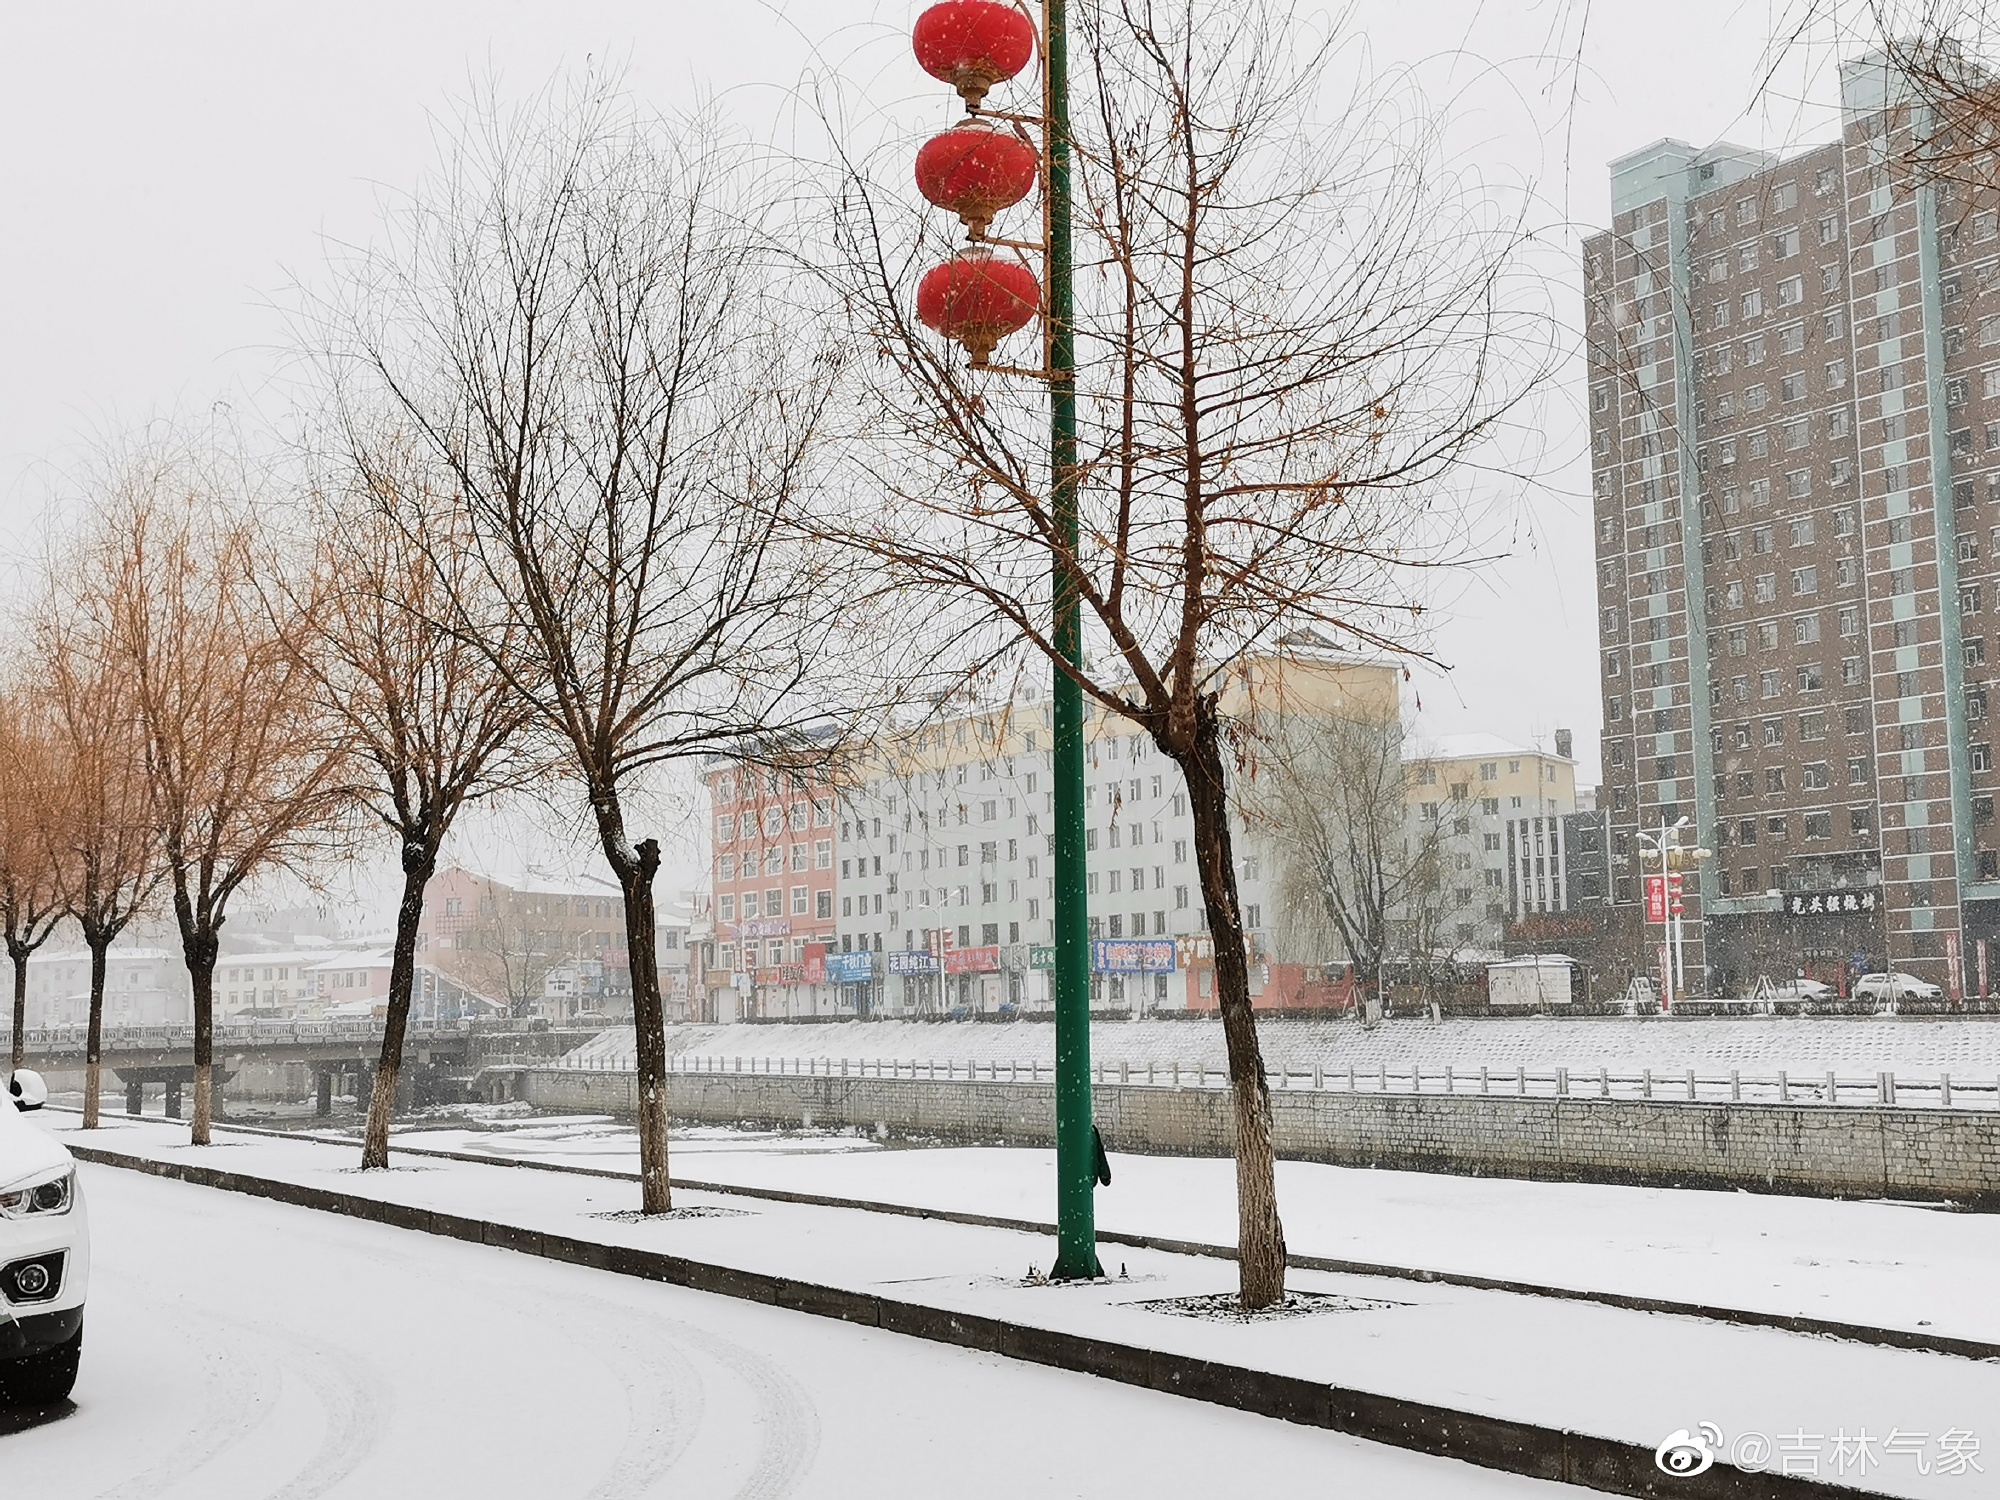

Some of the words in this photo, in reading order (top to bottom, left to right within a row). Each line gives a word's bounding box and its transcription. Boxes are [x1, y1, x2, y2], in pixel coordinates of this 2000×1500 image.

[1791, 892, 1875, 915] 光头强烧烤
